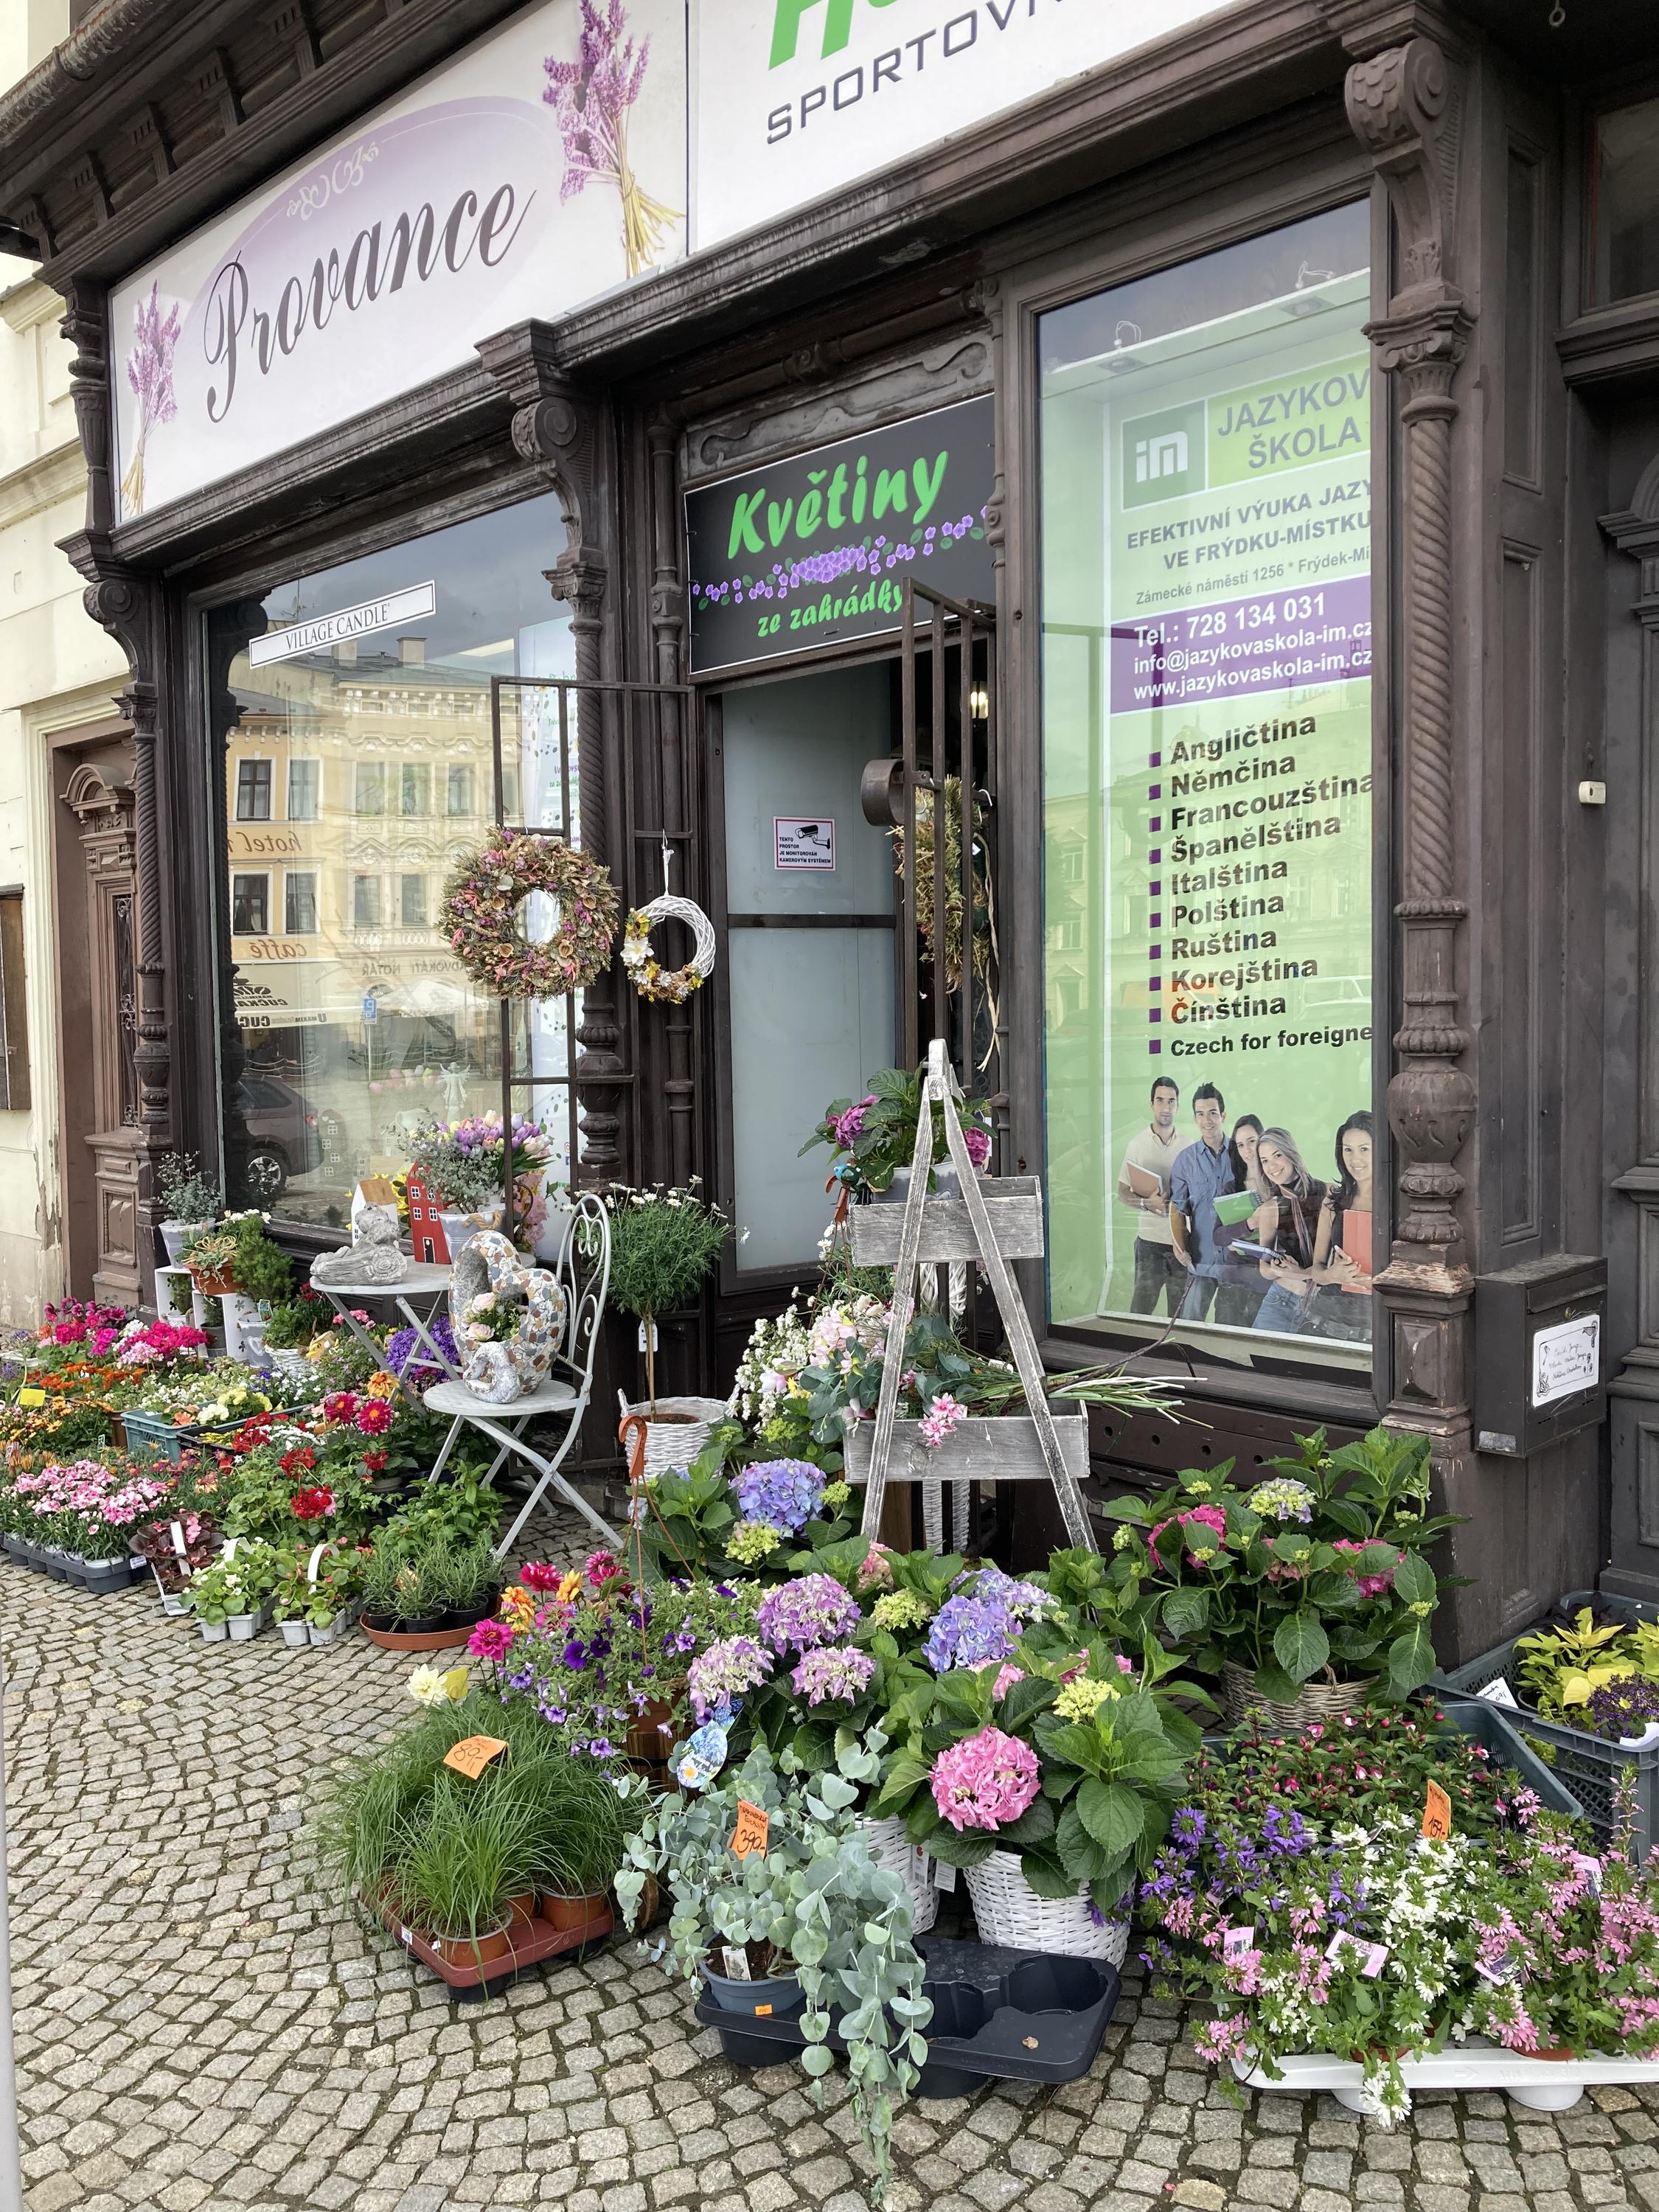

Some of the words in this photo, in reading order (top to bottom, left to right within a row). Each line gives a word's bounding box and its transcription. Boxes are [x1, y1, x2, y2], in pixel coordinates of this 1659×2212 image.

[204, 184, 537, 422] Provance
[1248, 417, 1362, 469] ŠKOLA
[728, 451, 949, 560] Květiny
[1127, 507, 1231, 550] EFEKTIVNÍ
[1237, 493, 1312, 524] VÝUKA
[1136, 581, 1192, 605] Zámecké
[1196, 570, 1249, 595] náměstí
[1253, 563, 1284, 582] 1256
[1164, 550, 1189, 570] VE
[757, 613, 781, 638] ze
[790, 579, 903, 630] zahrádky
[1134, 624, 1178, 648] Tel.:
[1186, 611, 1226, 640] 728
[1234, 602, 1276, 631] 134
[1283, 592, 1325, 622] 031
[285, 621, 333, 650] VILLAGE
[1134, 620, 1371, 675] info@jazykovaskola-im.cz
[1134, 650, 1371, 700] www.jazykovaskola-im.cz
[1170, 715, 1316, 765] Angličtina
[1171, 755, 1296, 798] Němčina
[1171, 773, 1372, 830] Francouzština
[1170, 816, 1340, 866] Španělština
[1171, 859, 1288, 895] Italština
[1172, 894, 1284, 928] Polština
[1171, 930, 1277, 960] Ruština
[1171, 958, 1318, 992] Korejština
[1171, 995, 1286, 1024] Čínština
[1171, 1035, 1234, 1057] Czech
[1241, 1032, 1271, 1052] for
